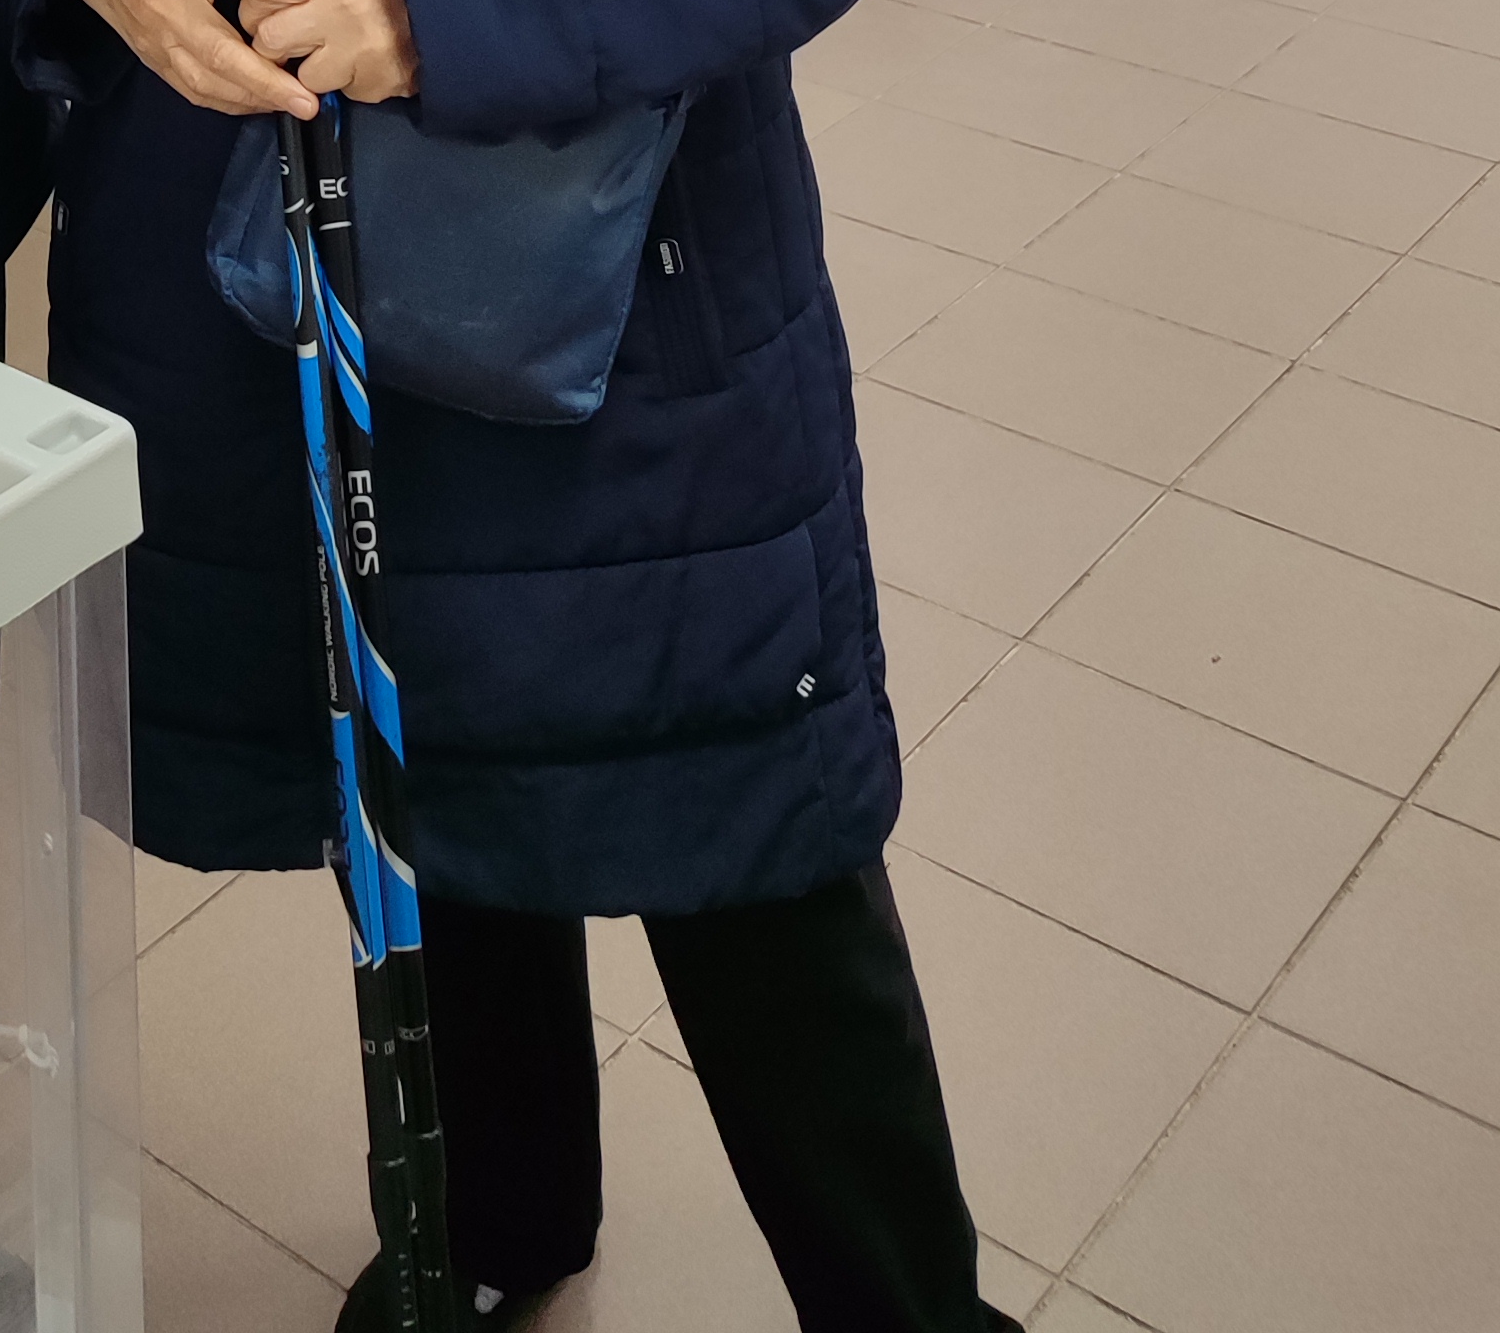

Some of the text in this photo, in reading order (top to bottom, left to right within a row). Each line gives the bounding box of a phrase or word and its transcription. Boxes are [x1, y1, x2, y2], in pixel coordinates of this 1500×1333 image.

[347, 469, 380, 577] ECOS
[316, 544, 339, 703] NORDIC WALKING POLE
